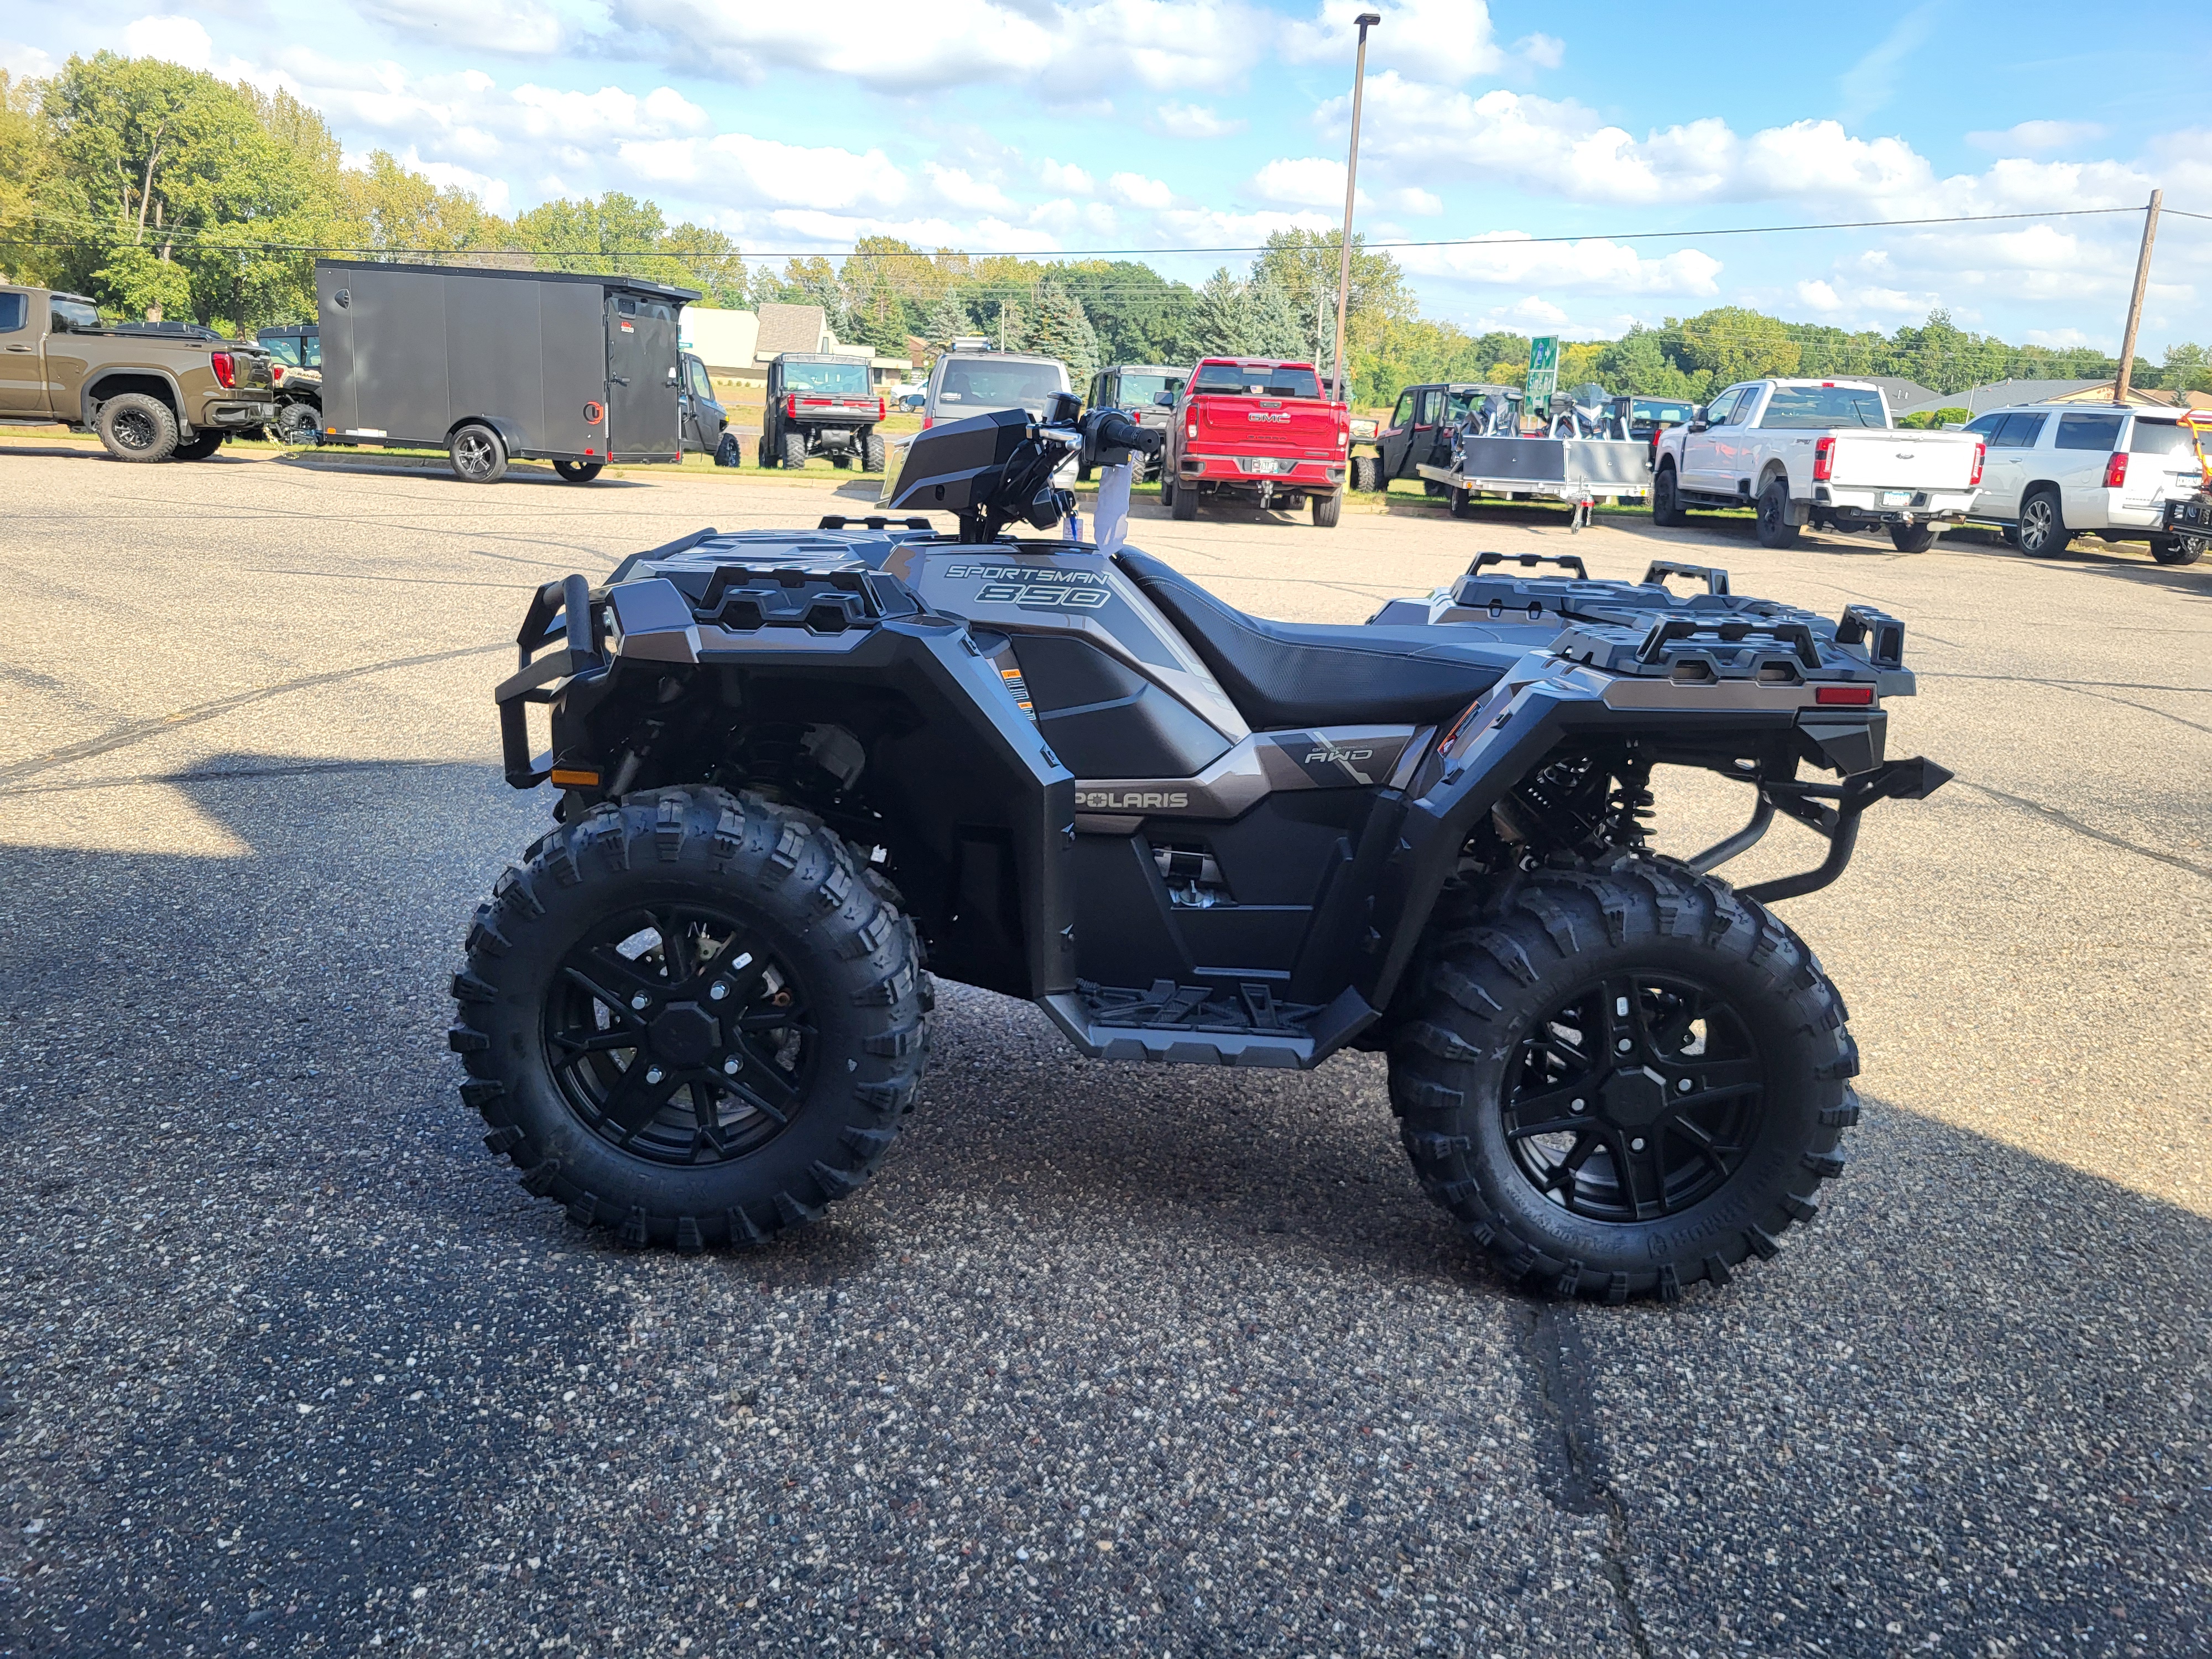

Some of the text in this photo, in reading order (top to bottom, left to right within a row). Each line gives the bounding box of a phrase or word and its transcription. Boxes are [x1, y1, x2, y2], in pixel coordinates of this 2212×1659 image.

[1529, 376, 1552, 390] Sims Rd
[1249, 413, 1291, 424] GMC
[945, 565, 1109, 585] SPORTSMAN
[974, 582, 1111, 608] 850
[1305, 749, 1373, 764] AWD
[1076, 792, 1188, 808] POLARIS
